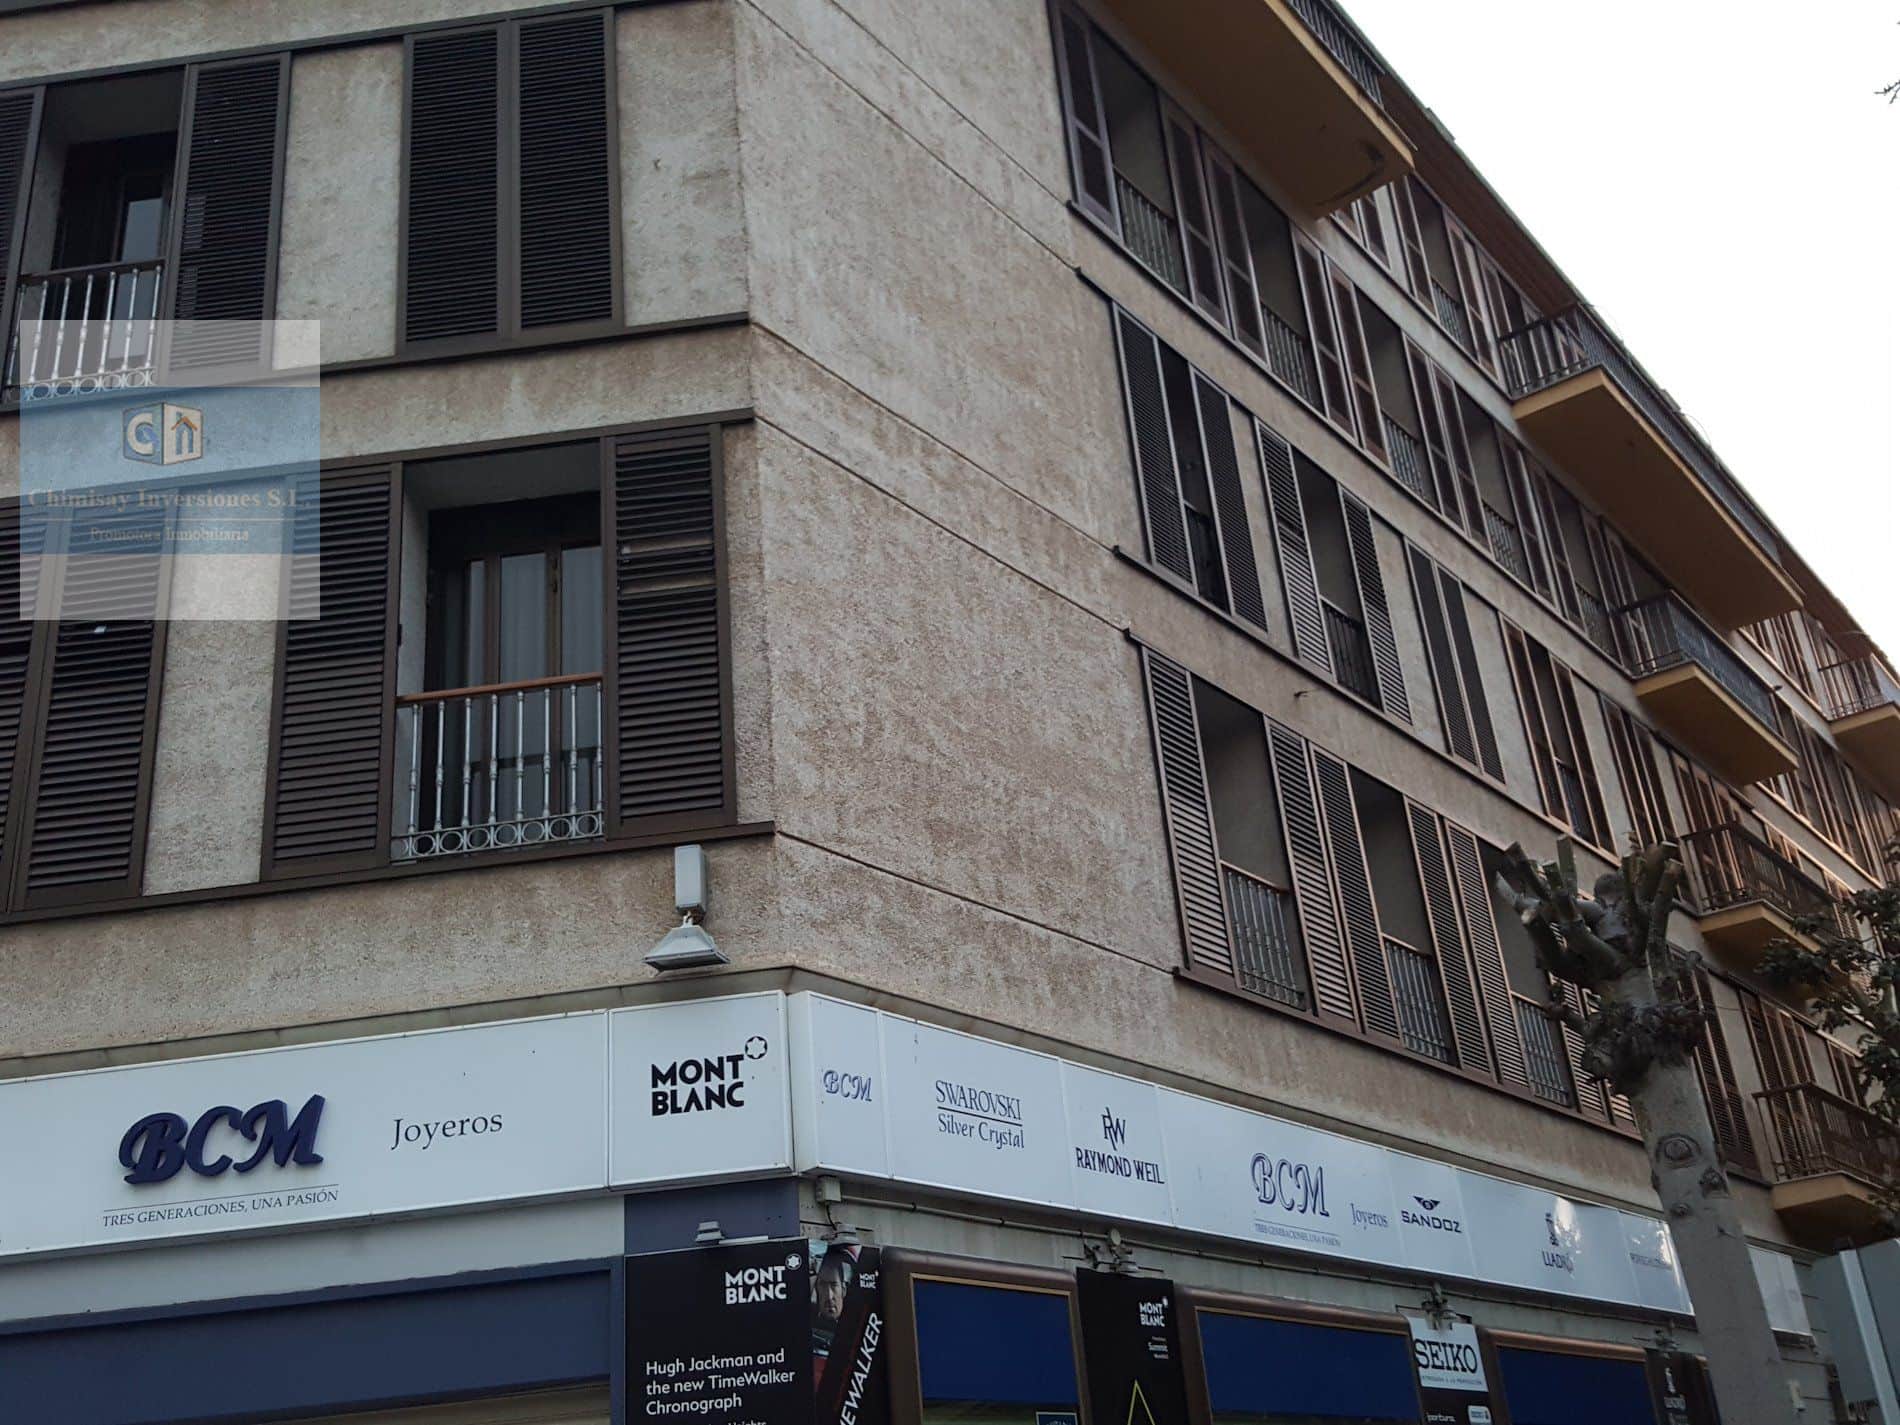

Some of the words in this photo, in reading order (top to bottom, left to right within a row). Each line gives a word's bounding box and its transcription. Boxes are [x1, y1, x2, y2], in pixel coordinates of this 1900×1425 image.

[651, 1054, 744, 1088] MONT
[823, 1069, 873, 1101] BCM
[651, 1081, 745, 1117] BLANC
[935, 1080, 1022, 1121] SWAROVSKI
[118, 1094, 326, 1184] BCM
[391, 1113, 503, 1150] Joyeros
[937, 1114, 975, 1138] Silver
[978, 1121, 1025, 1149] Crystal
[1075, 1147, 1133, 1178] RAYMOND
[1133, 1159, 1165, 1184] WEIL
[103, 1213, 135, 1227] TRES
[137, 1202, 249, 1223] GENERACIONES,
[252, 1197, 283, 1211] UNA
[286, 1189, 340, 1206] PASIÓN
[1251, 1153, 1330, 1217] BCM
[1350, 1202, 1390, 1230] Joyeros
[1401, 1210, 1462, 1233] SANDOZ
[725, 1266, 786, 1288] MONT
[726, 1283, 787, 1305] BLANC
[1139, 1302, 1163, 1314] MONT
[1140, 1314, 1166, 1327] BLANC
[646, 1361, 685, 1378] Hugh
[688, 1353, 753, 1371] Jackman
[757, 1348, 785, 1364] and
[839, 1312, 883, 1425] EWALKER
[1415, 1339, 1478, 1374] SEIKO
[646, 1382, 671, 1396] the
[674, 1379, 704, 1393] new
[708, 1369, 796, 1390] TimeWalker
[646, 1393, 743, 1415] Chronograph
